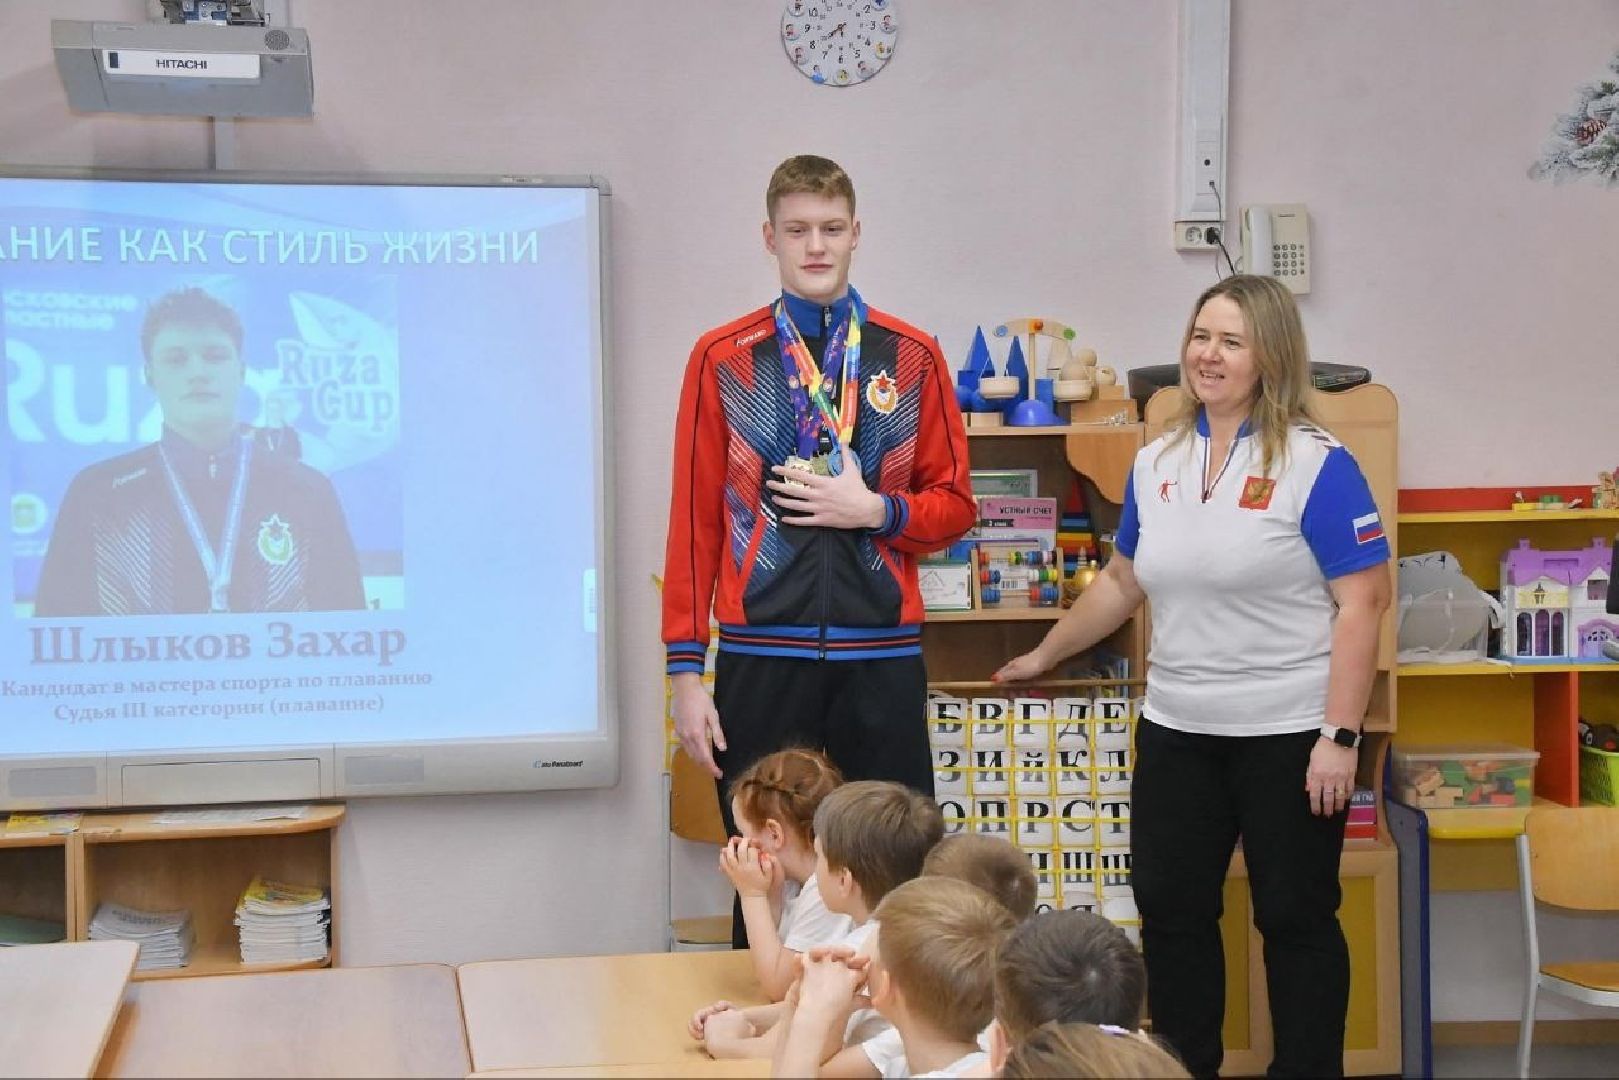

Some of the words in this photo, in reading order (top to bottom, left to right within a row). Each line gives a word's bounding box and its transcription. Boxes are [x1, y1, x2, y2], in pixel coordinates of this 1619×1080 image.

[804, 24, 811, 33] 9
[156, 59, 208, 70] HITACHI
[0, 225, 102, 262] НИЕ
[120, 228, 209, 263] КАК
[222, 229, 368, 265] СТИЛЬ
[382, 230, 539, 265] ЖИЗНИ
[278, 341, 381, 386] Ruza
[317, 380, 393, 432] Cup
[29, 626, 251, 664] Шлыков
[267, 621, 406, 666] Захар
[1, 680, 109, 698] Кандидат
[112, 682, 124, 694] в
[131, 679, 216, 695] мастера
[221, 677, 291, 694] спорта
[298, 676, 323, 688] по
[328, 673, 433, 687] плаванию
[54, 704, 116, 724] Судья
[154, 702, 264, 719] категории
[270, 695, 384, 716] (плавание)
[934, 703, 962, 733] Б
[975, 703, 1003, 734] В
[1020, 703, 1046, 735] Г
[1058, 704, 1090, 742] Д
[1100, 702, 1126, 734] Е
[937, 750, 960, 782] З
[974, 750, 1005, 782] И
[1059, 750, 1090, 781] К
[1100, 750, 1130, 782] Л
[977, 800, 1009, 833] П
[1024, 802, 1049, 833] Р
[1062, 800, 1095, 833] С
[1101, 802, 1130, 834] Т
[1063, 852, 1094, 883] Ш
